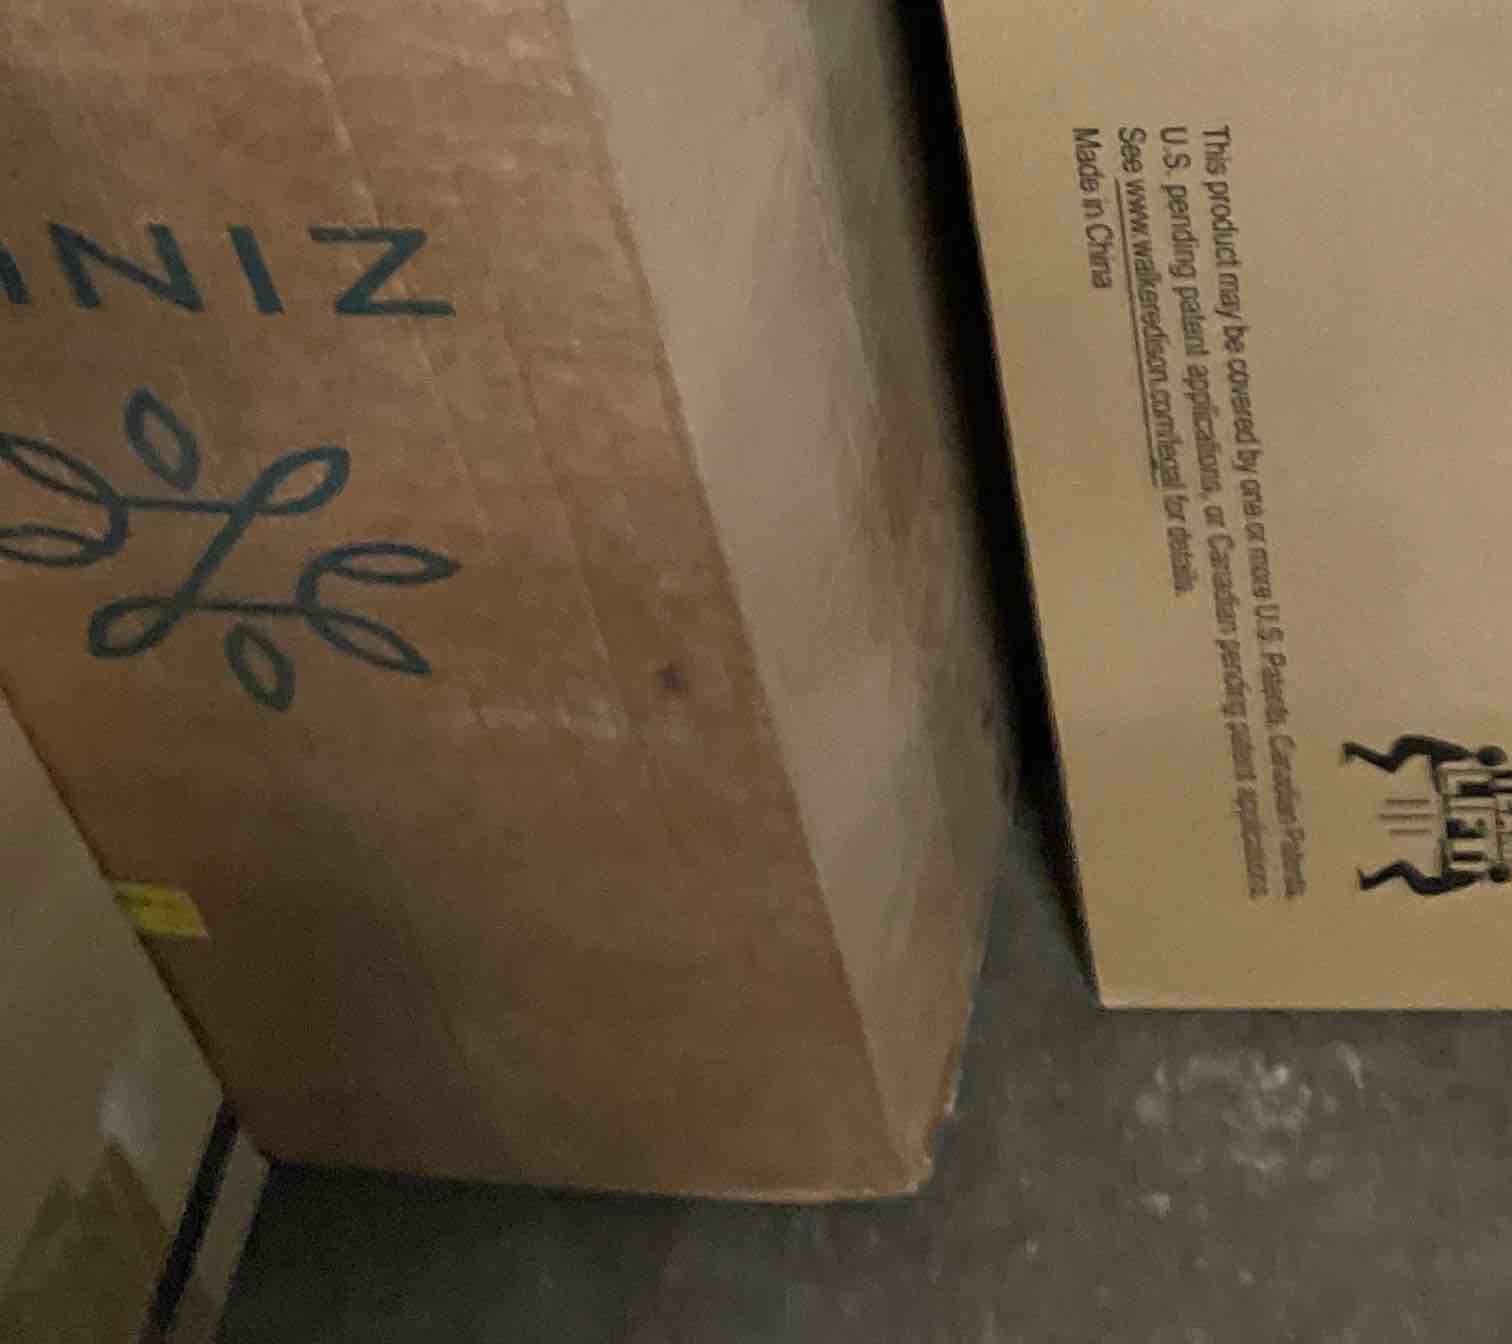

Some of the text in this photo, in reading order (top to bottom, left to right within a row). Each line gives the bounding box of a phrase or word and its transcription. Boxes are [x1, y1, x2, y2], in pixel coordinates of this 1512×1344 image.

[1160, 125, 1192, 178] U.S.
[1202, 124, 1232, 176] This
[1071, 126, 1115, 289] Made in China
[1160, 182, 1200, 280] pending
[1202, 180, 1242, 270] product
[1117, 125, 1148, 174] See
[1163, 493, 1190, 522] for
[1172, 284, 1211, 358] patent
[1215, 272, 1242, 321] may
[1223, 324, 1250, 355] be
[1228, 358, 1263, 446] covered
[1232, 449, 1263, 474] by
[1203, 503, 1226, 530] or
[1207, 532, 1242, 636] Canadian
[1248, 546, 1272, 602] more
[1438, 768, 1498, 870] LIFT
